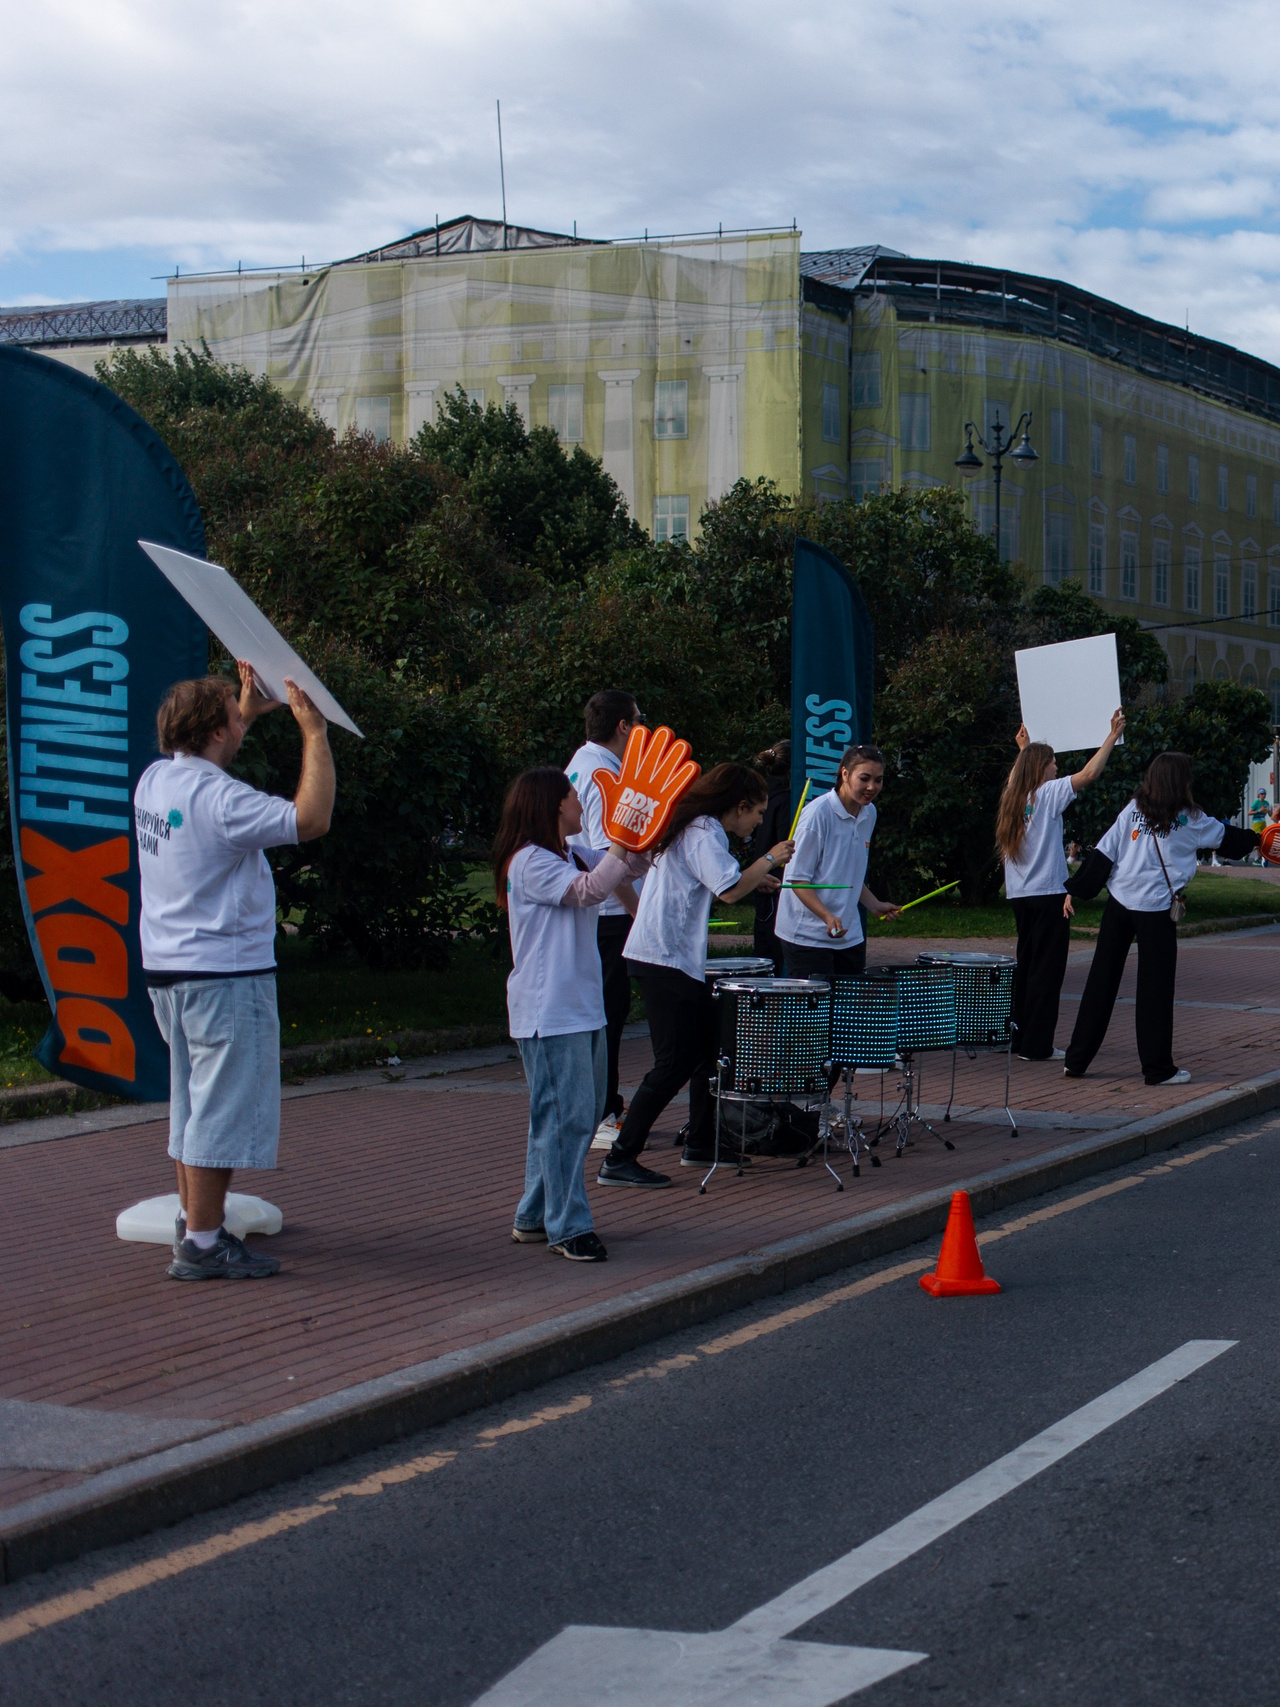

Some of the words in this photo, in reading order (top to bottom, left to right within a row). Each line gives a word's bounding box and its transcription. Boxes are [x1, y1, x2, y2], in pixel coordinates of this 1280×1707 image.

[20, 603, 128, 830] FITNESS
[805, 693, 852, 804] TNESS
[136, 807, 171, 840] НИРУЙСЯ
[612, 803, 652, 836] FITNESS
[619, 787, 660, 818] DDX
[21, 826, 135, 1081] DDX
